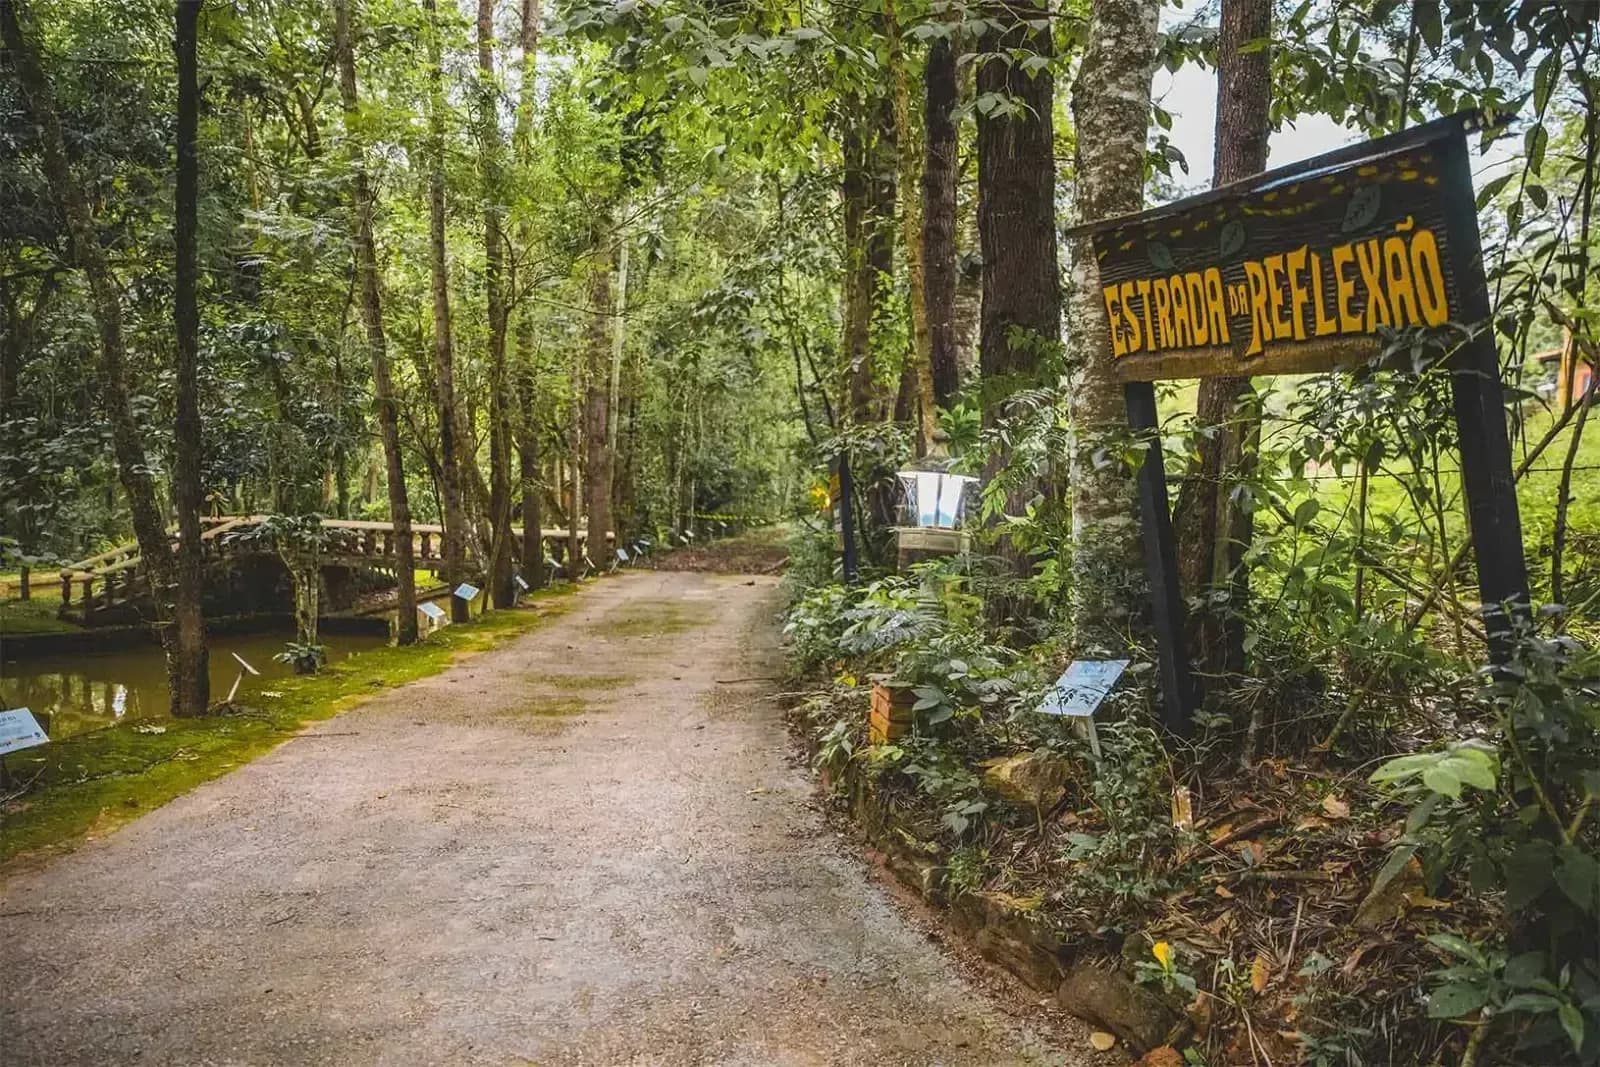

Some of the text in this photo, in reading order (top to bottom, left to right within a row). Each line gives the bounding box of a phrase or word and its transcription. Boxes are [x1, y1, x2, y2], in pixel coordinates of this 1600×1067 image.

[1104, 216, 1448, 357] ESTRADA DA REFLEXÃO
